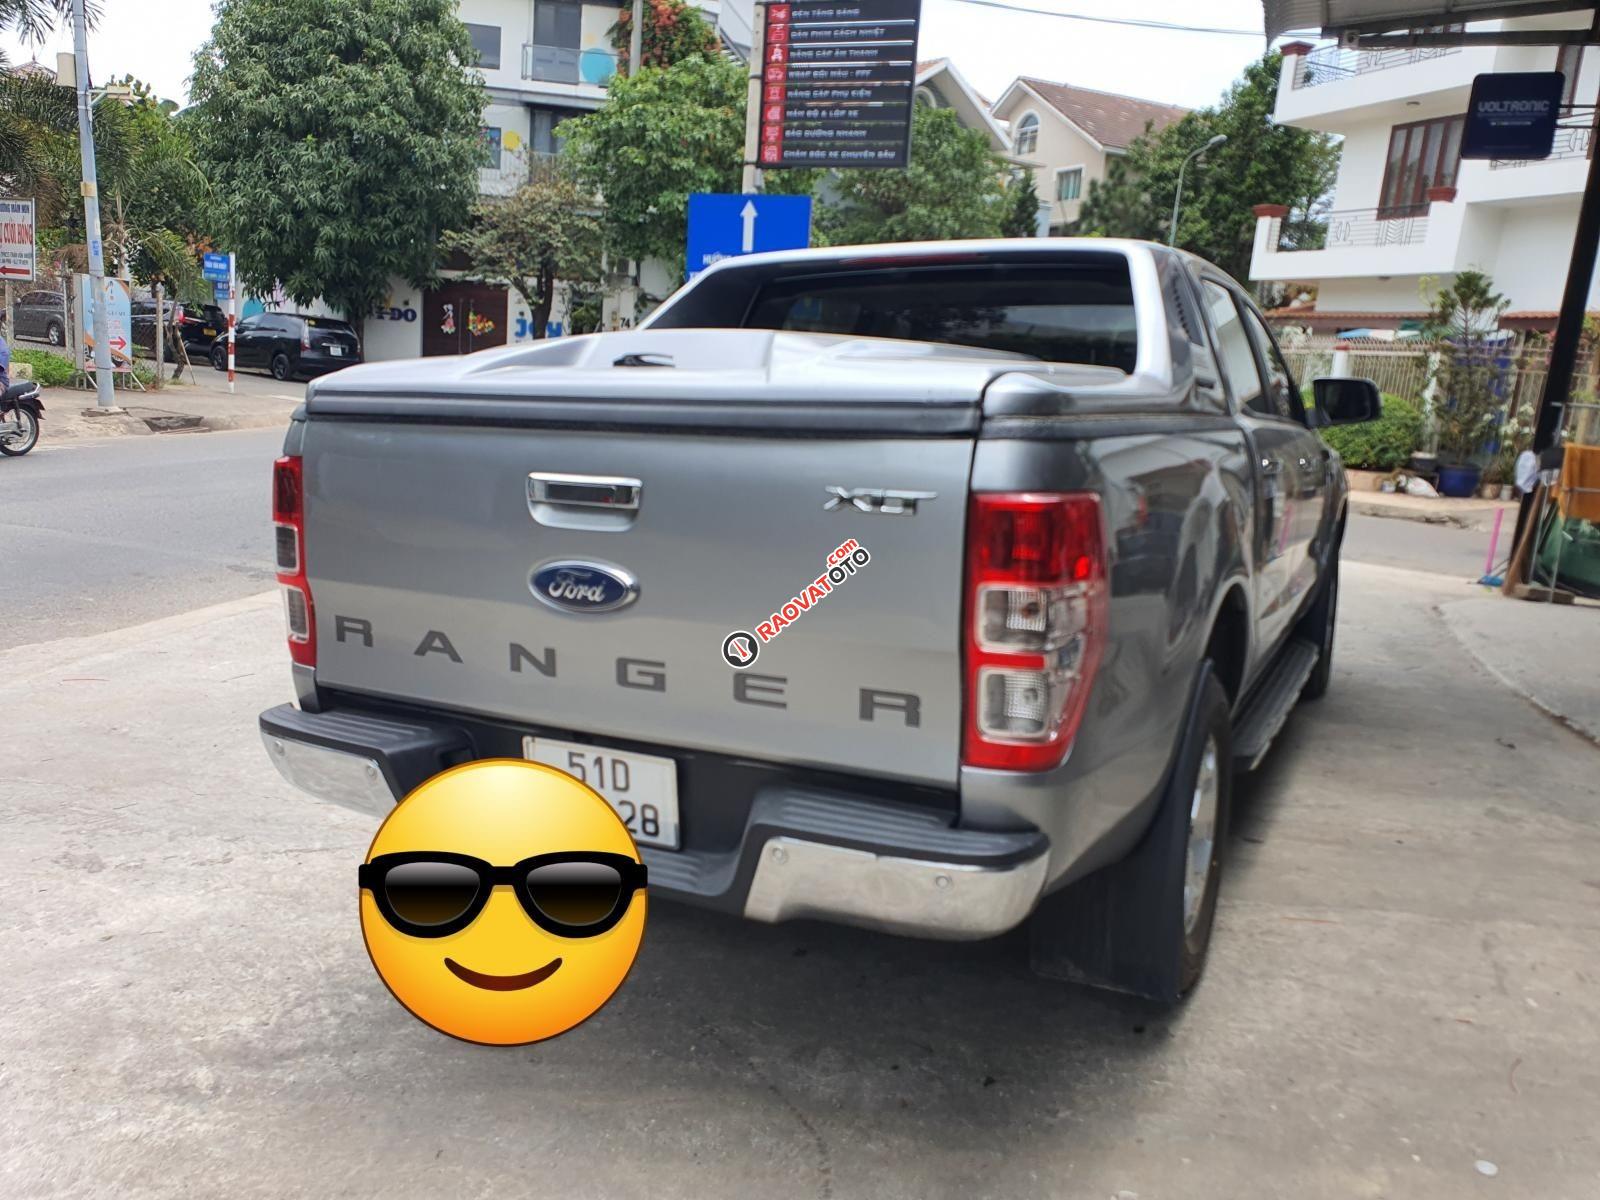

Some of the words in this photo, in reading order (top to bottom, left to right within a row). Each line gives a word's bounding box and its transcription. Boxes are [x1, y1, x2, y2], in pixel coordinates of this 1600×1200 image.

[620, 317, 631, 329] 74
[547, 569, 605, 604] Ford
[335, 614, 922, 728] RANGER
[568, 751, 630, 792] 51D
